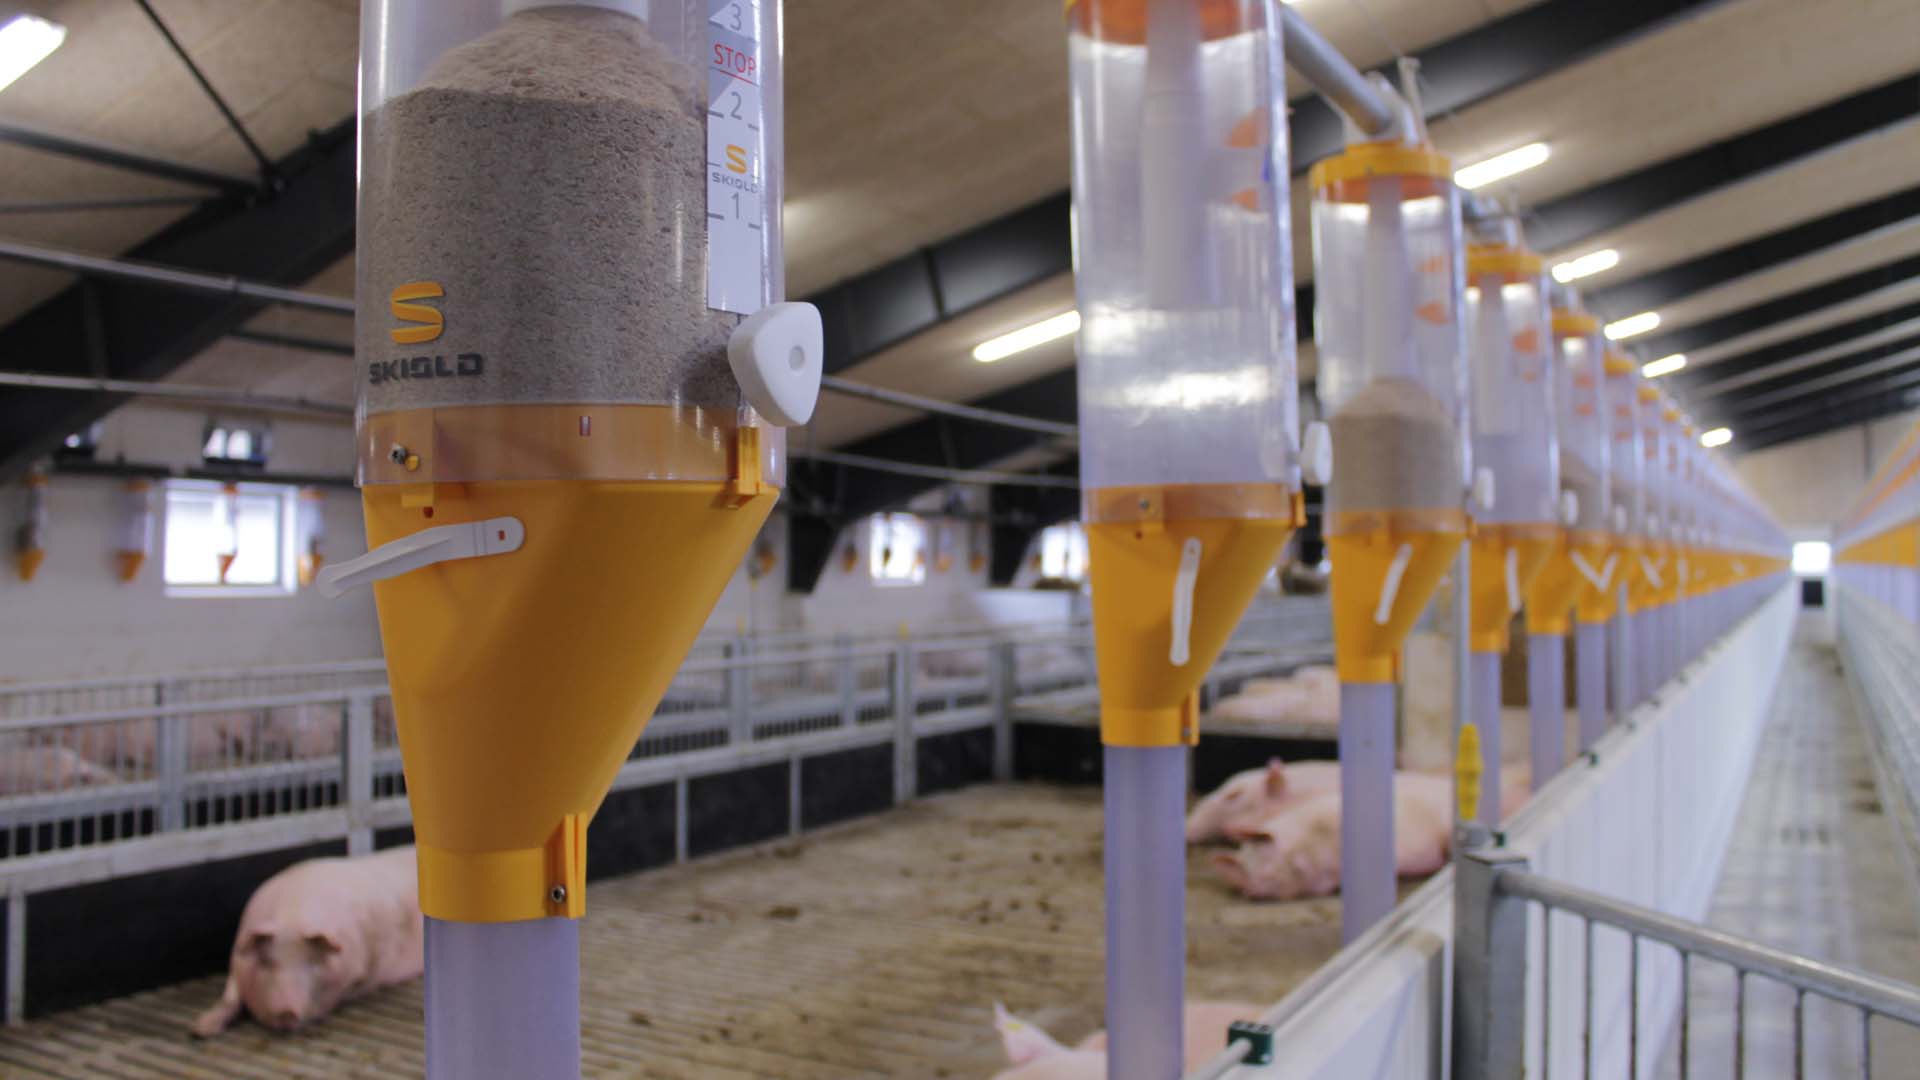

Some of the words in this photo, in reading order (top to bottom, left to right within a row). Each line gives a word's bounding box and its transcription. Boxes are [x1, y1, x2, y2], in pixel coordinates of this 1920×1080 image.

[730, 3, 742, 31] 3
[713, 43, 757, 76] STOP
[730, 91, 743, 121] 2
[725, 143, 748, 175] S
[731, 191, 740, 220] 1
[390, 281, 446, 345] S
[369, 353, 484, 385] SKIOLD
